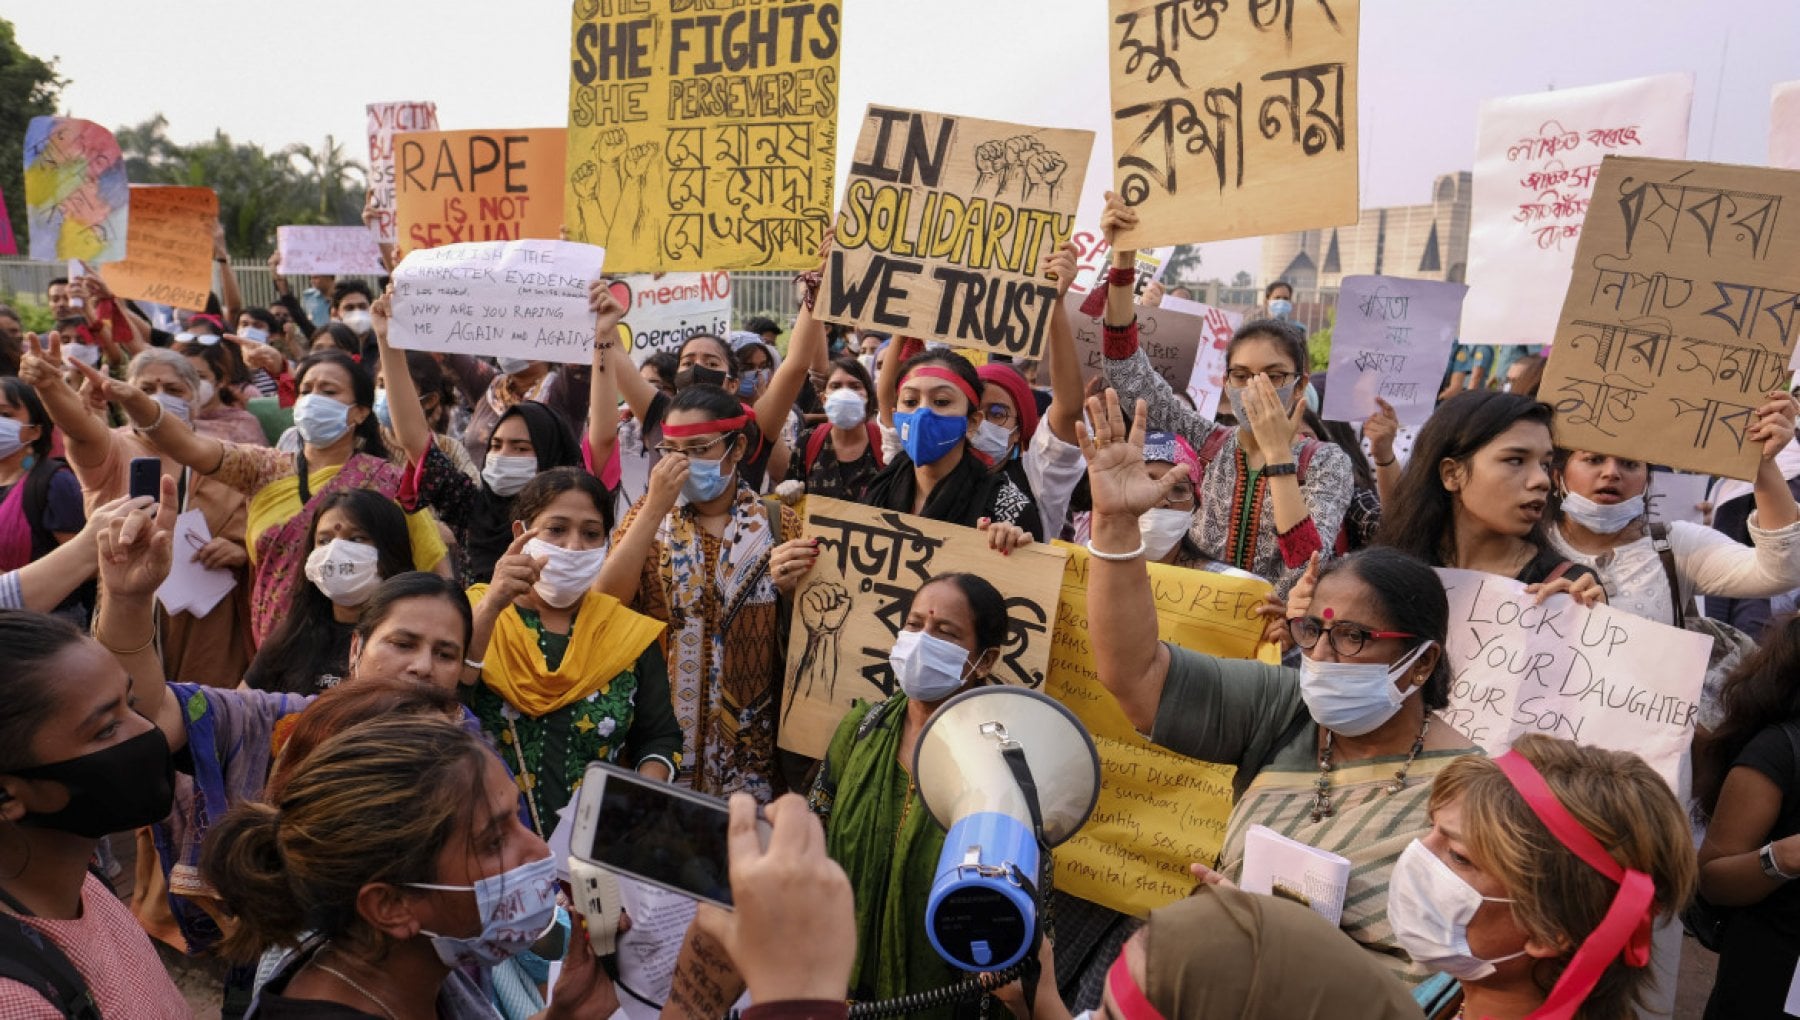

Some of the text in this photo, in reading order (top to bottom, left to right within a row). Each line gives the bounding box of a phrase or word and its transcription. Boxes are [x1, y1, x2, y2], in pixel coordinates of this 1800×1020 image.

[573, 3, 839, 86] SHE FIGHTS
[368, 102, 437, 130] VICTIM
[573, 65, 836, 127] SHE PERSEVERES
[402, 135, 530, 193] RAPE
[715, 121, 814, 166] মানুষ
[850, 107, 955, 187] IN
[443, 195, 530, 224] IS NOT
[836, 178, 1076, 281] SOLIDARITY
[1617, 168, 1782, 261] ধর্ষকরা
[403, 266, 587, 290] CHARACTER EVIDENCE
[518, 248, 555, 265] THE
[410, 303, 564, 319] WHY ARE YOU RAPING
[638, 270, 731, 308] means NO
[830, 250, 924, 329] WE
[934, 266, 1059, 357] TRUST
[414, 322, 433, 335] ME
[445, 321, 504, 343] AGAIN
[712, 316, 727, 336] is
[1570, 314, 1677, 378] নারী
[809, 513, 944, 593] লড়াই
[1467, 580, 1629, 657] LOCK UP
[1465, 627, 1699, 728] YOUR DAUGHTER
[1511, 696, 1585, 742] SON
[1067, 858, 1186, 898] marital status
